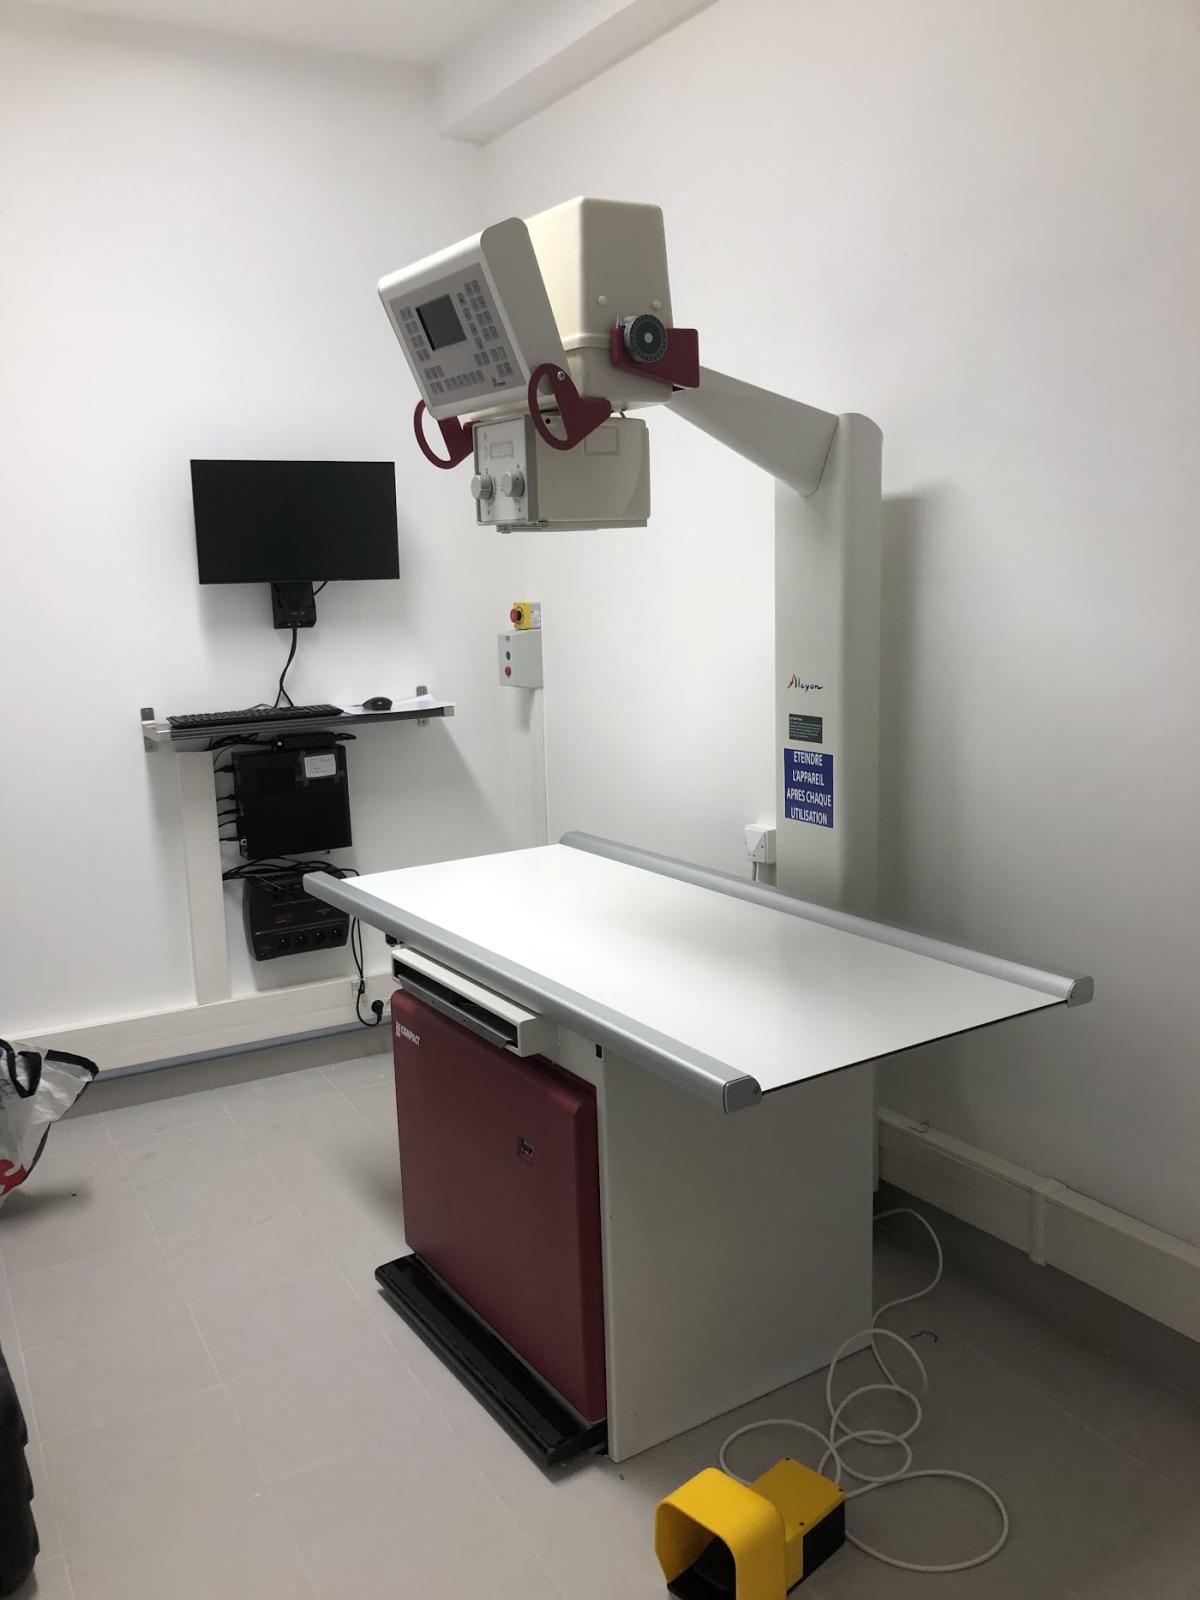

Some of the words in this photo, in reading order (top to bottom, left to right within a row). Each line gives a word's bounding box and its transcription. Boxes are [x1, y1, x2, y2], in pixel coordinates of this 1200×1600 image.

[787, 673, 823, 693] Alcyon
[793, 751, 823, 766] ETEINDRE
[792, 769, 824, 786] L'APPAREIL
[786, 787, 805, 801] APRES
[806, 791, 832, 807] CHAQUE
[791, 806, 828, 825] UTILISATION
